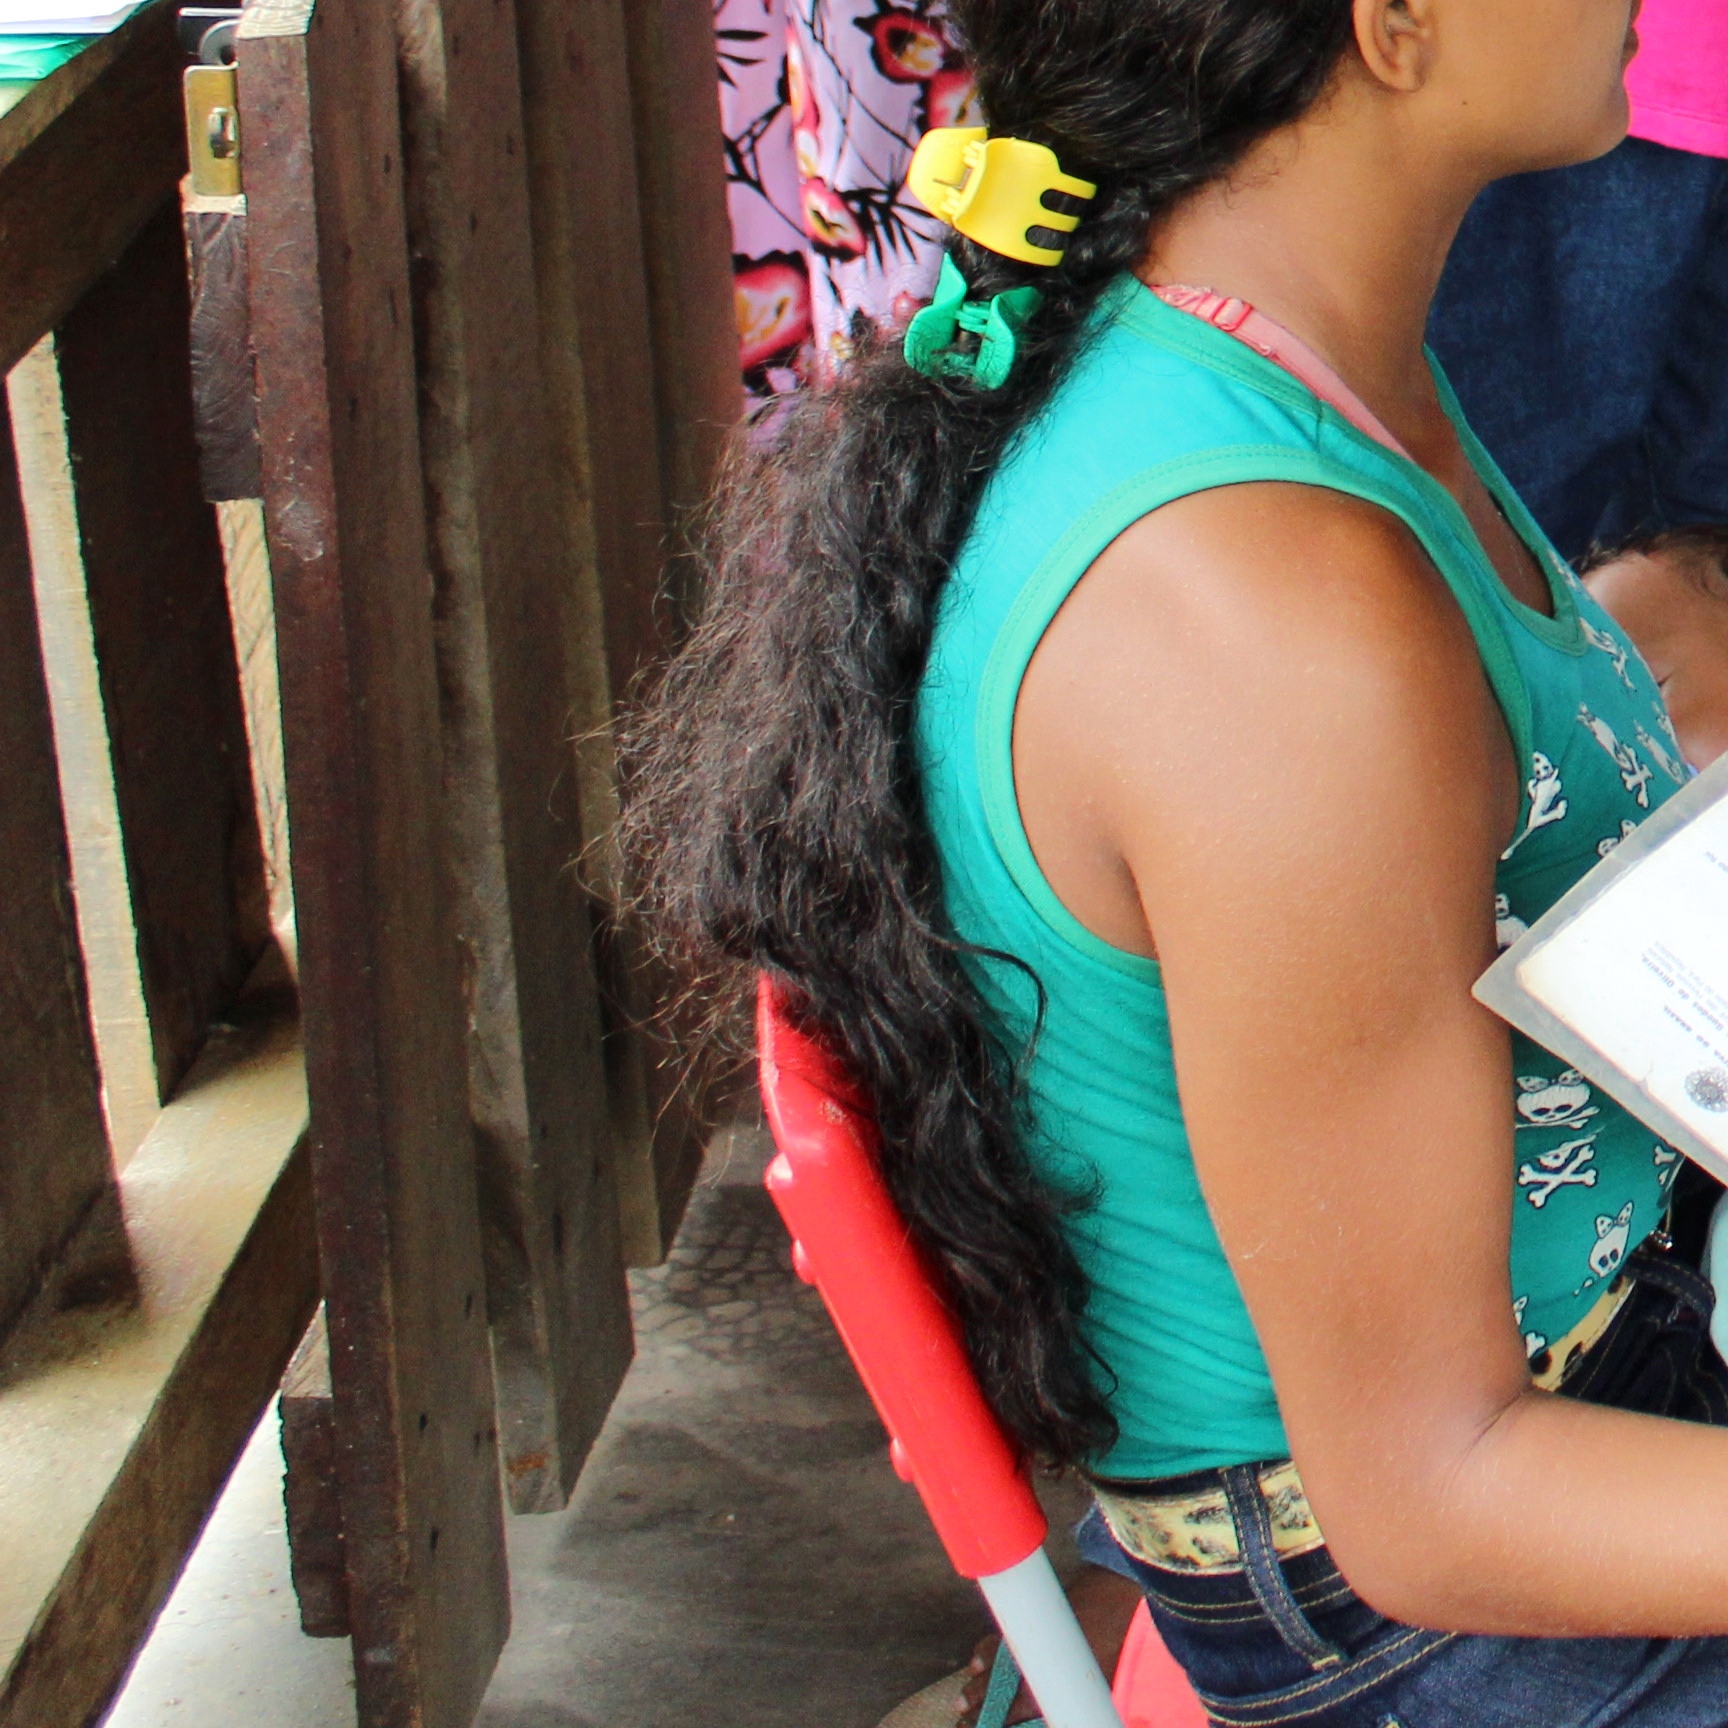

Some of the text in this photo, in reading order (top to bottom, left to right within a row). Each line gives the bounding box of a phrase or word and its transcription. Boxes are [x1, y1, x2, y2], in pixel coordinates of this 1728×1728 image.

[1676, 986, 1690, 1001] de
[1661, 1003, 1693, 1034] BRASIL
[1690, 999, 1725, 1032] Guedes
[1694, 1032, 1711, 1049] DO
